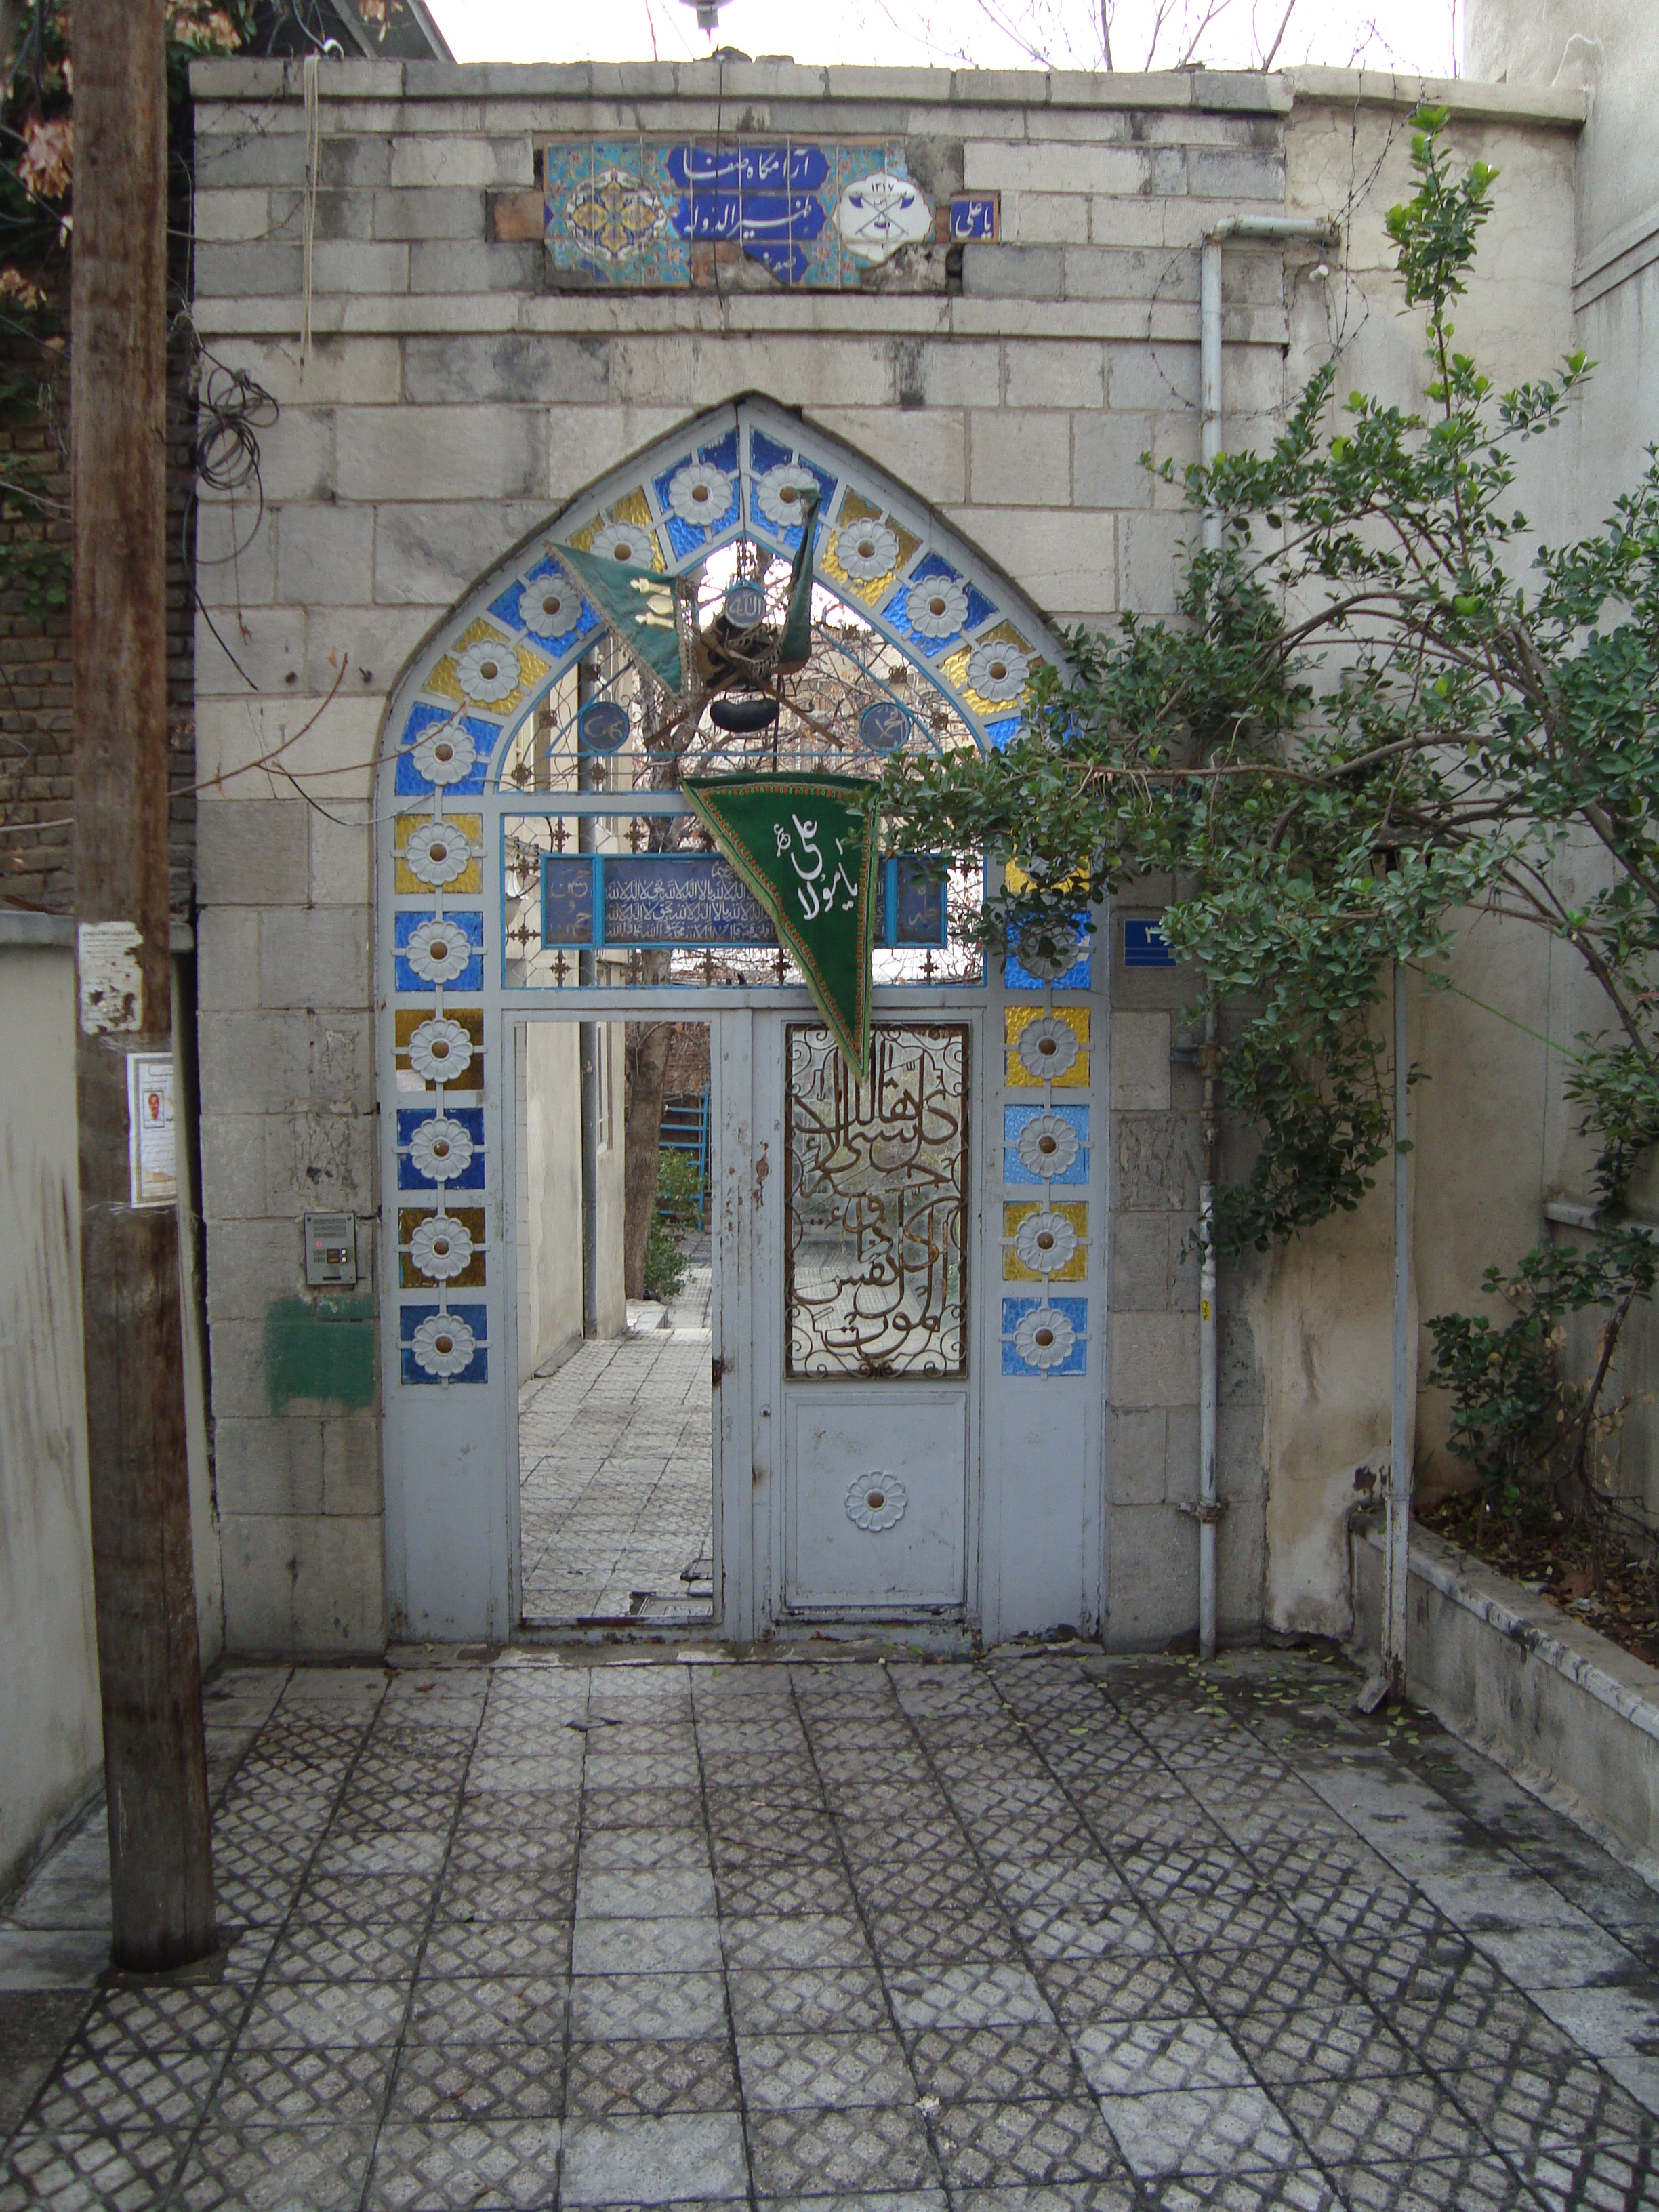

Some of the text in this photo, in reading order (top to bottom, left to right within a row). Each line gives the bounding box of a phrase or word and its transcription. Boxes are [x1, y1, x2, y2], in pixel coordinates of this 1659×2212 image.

[683, 147, 750, 180] صفا
[954, 201, 993, 239] یا علی
[790, 813, 823, 880] علی
